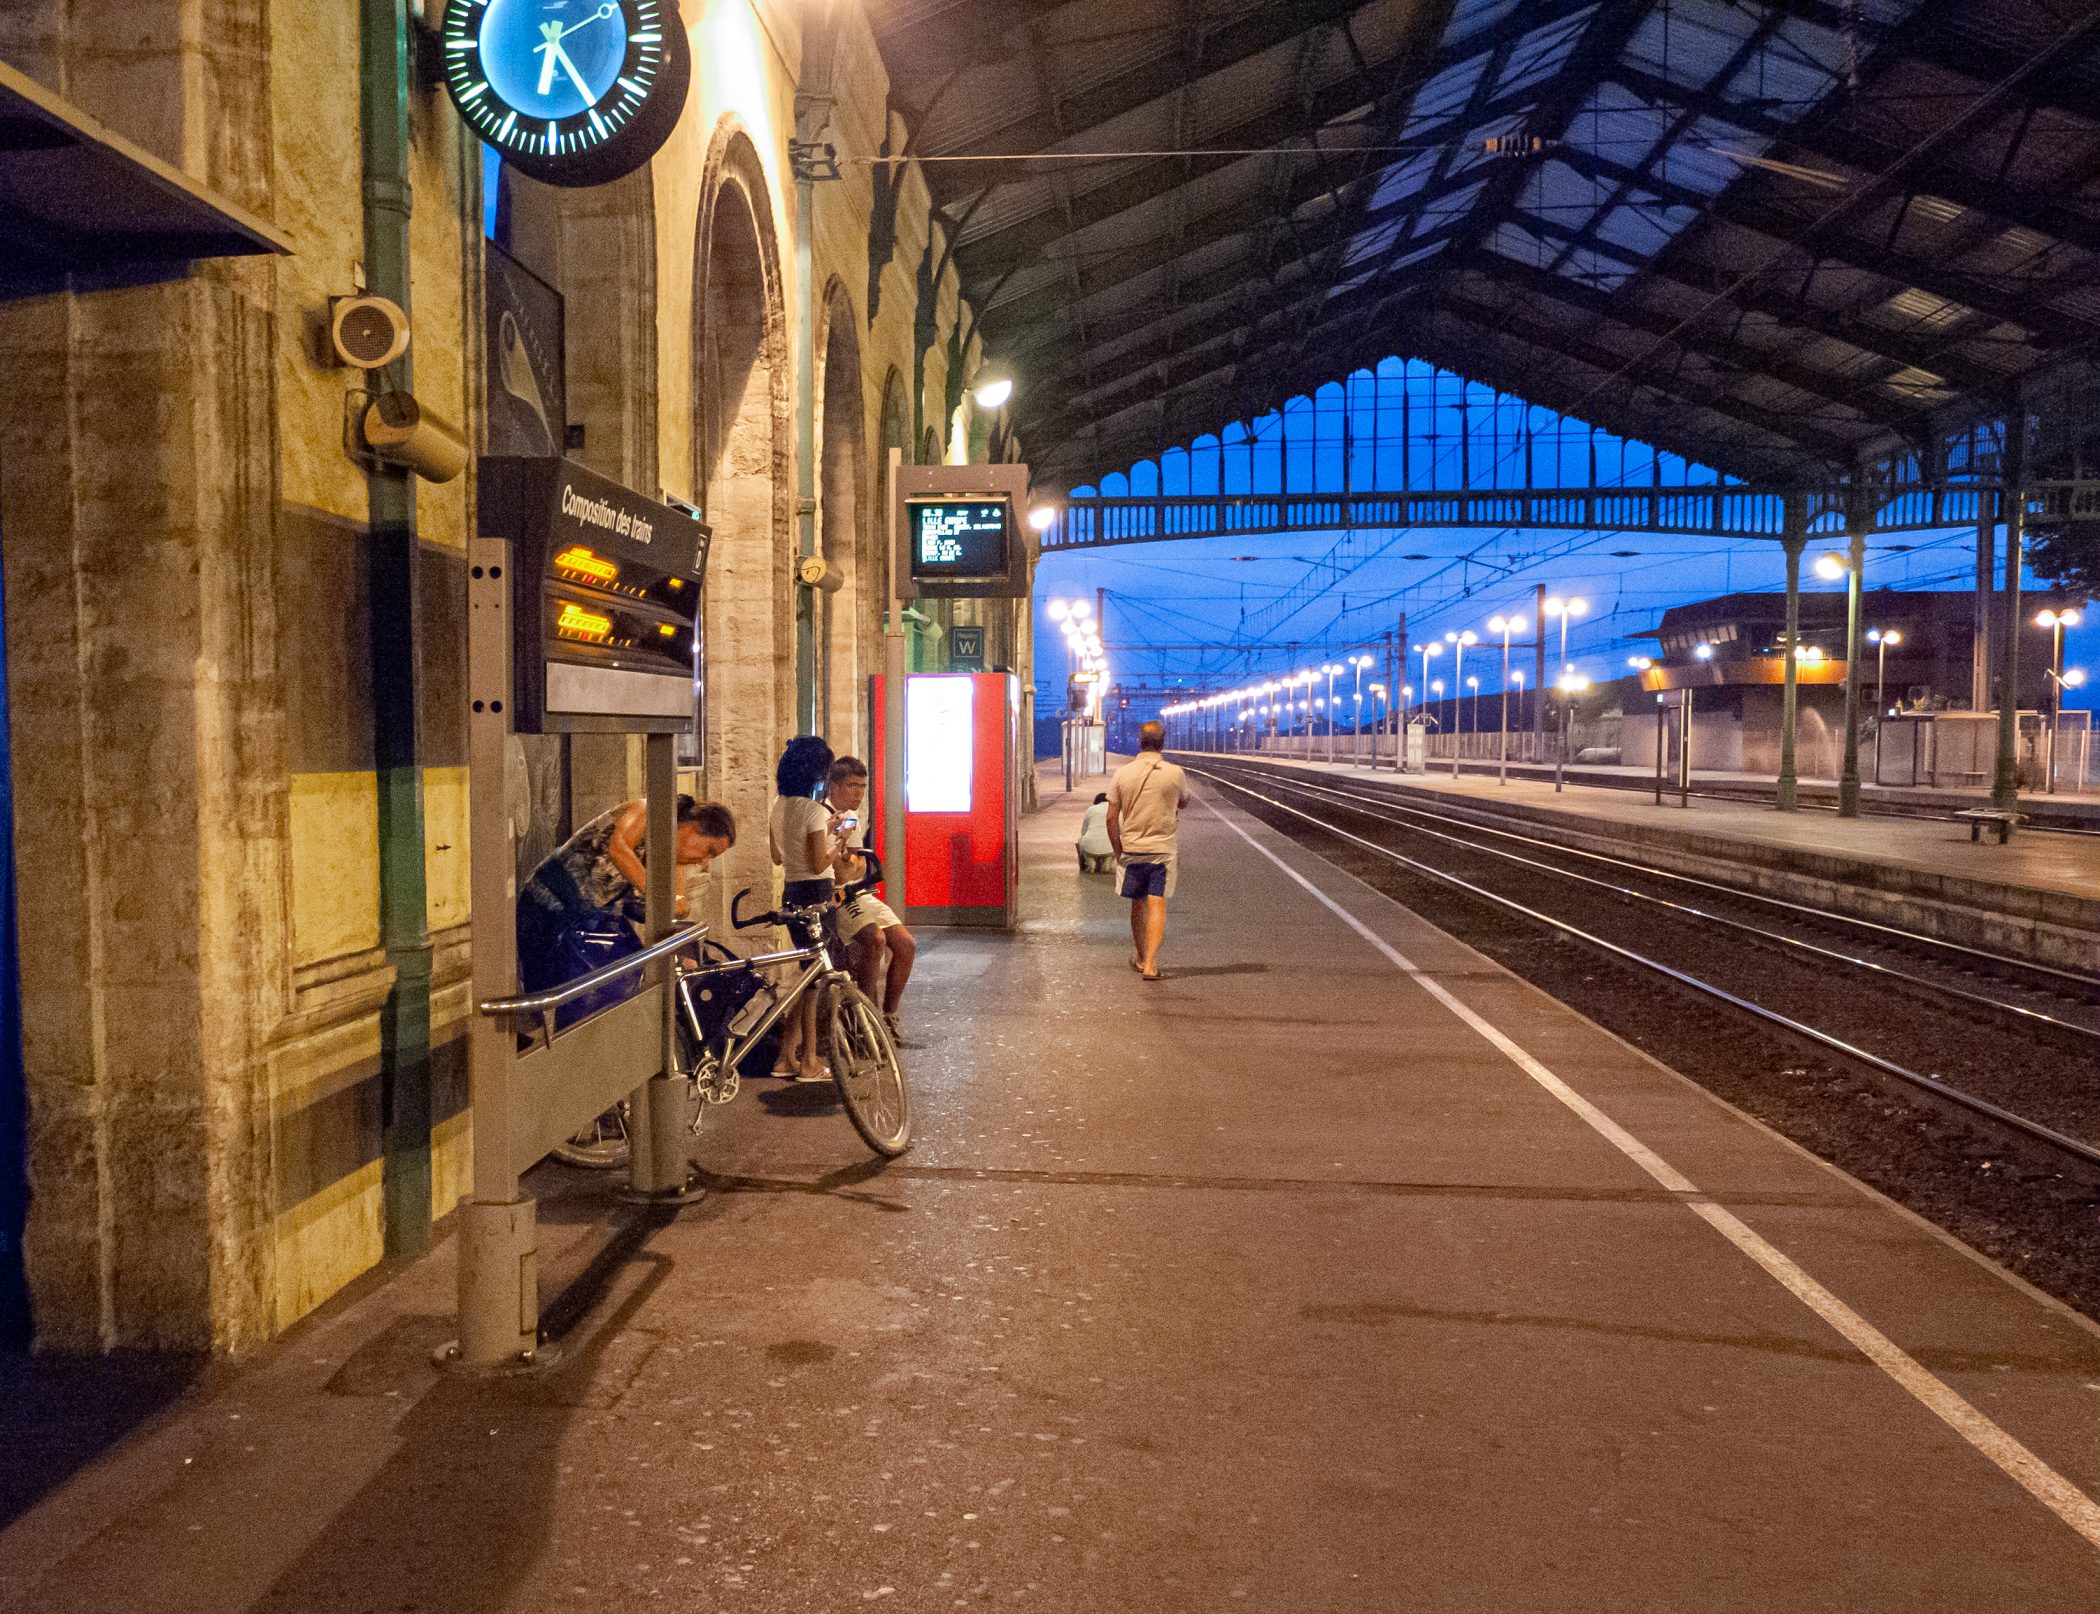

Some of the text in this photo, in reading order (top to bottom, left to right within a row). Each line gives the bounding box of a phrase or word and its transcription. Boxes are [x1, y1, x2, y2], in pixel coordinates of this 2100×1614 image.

[562, 484, 653, 545] Composition des trains
[959, 640, 976, 655] W
